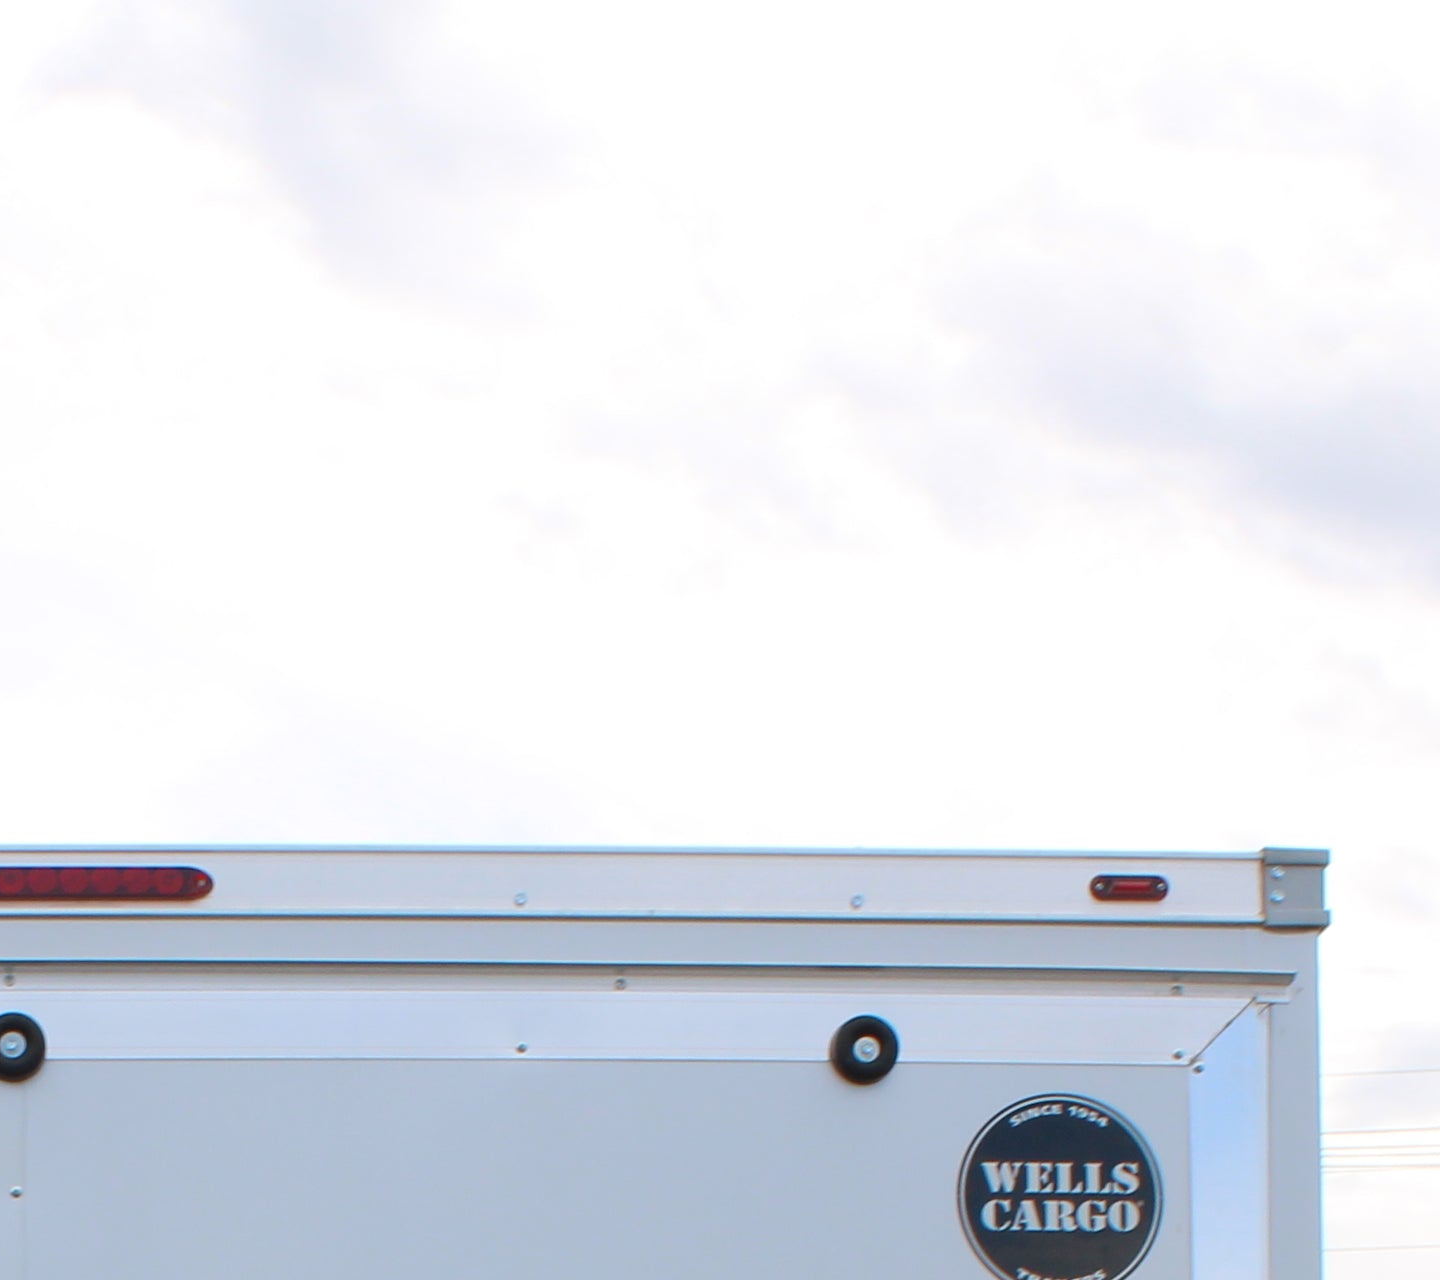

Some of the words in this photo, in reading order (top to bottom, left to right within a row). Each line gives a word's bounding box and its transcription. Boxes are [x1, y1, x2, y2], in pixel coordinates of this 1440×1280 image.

[1009, 1103, 1063, 1127] SINCE
[1068, 1105, 1109, 1128] 1954
[980, 1161, 1140, 1194] WELLS
[979, 1199, 1141, 1232] CARGO
